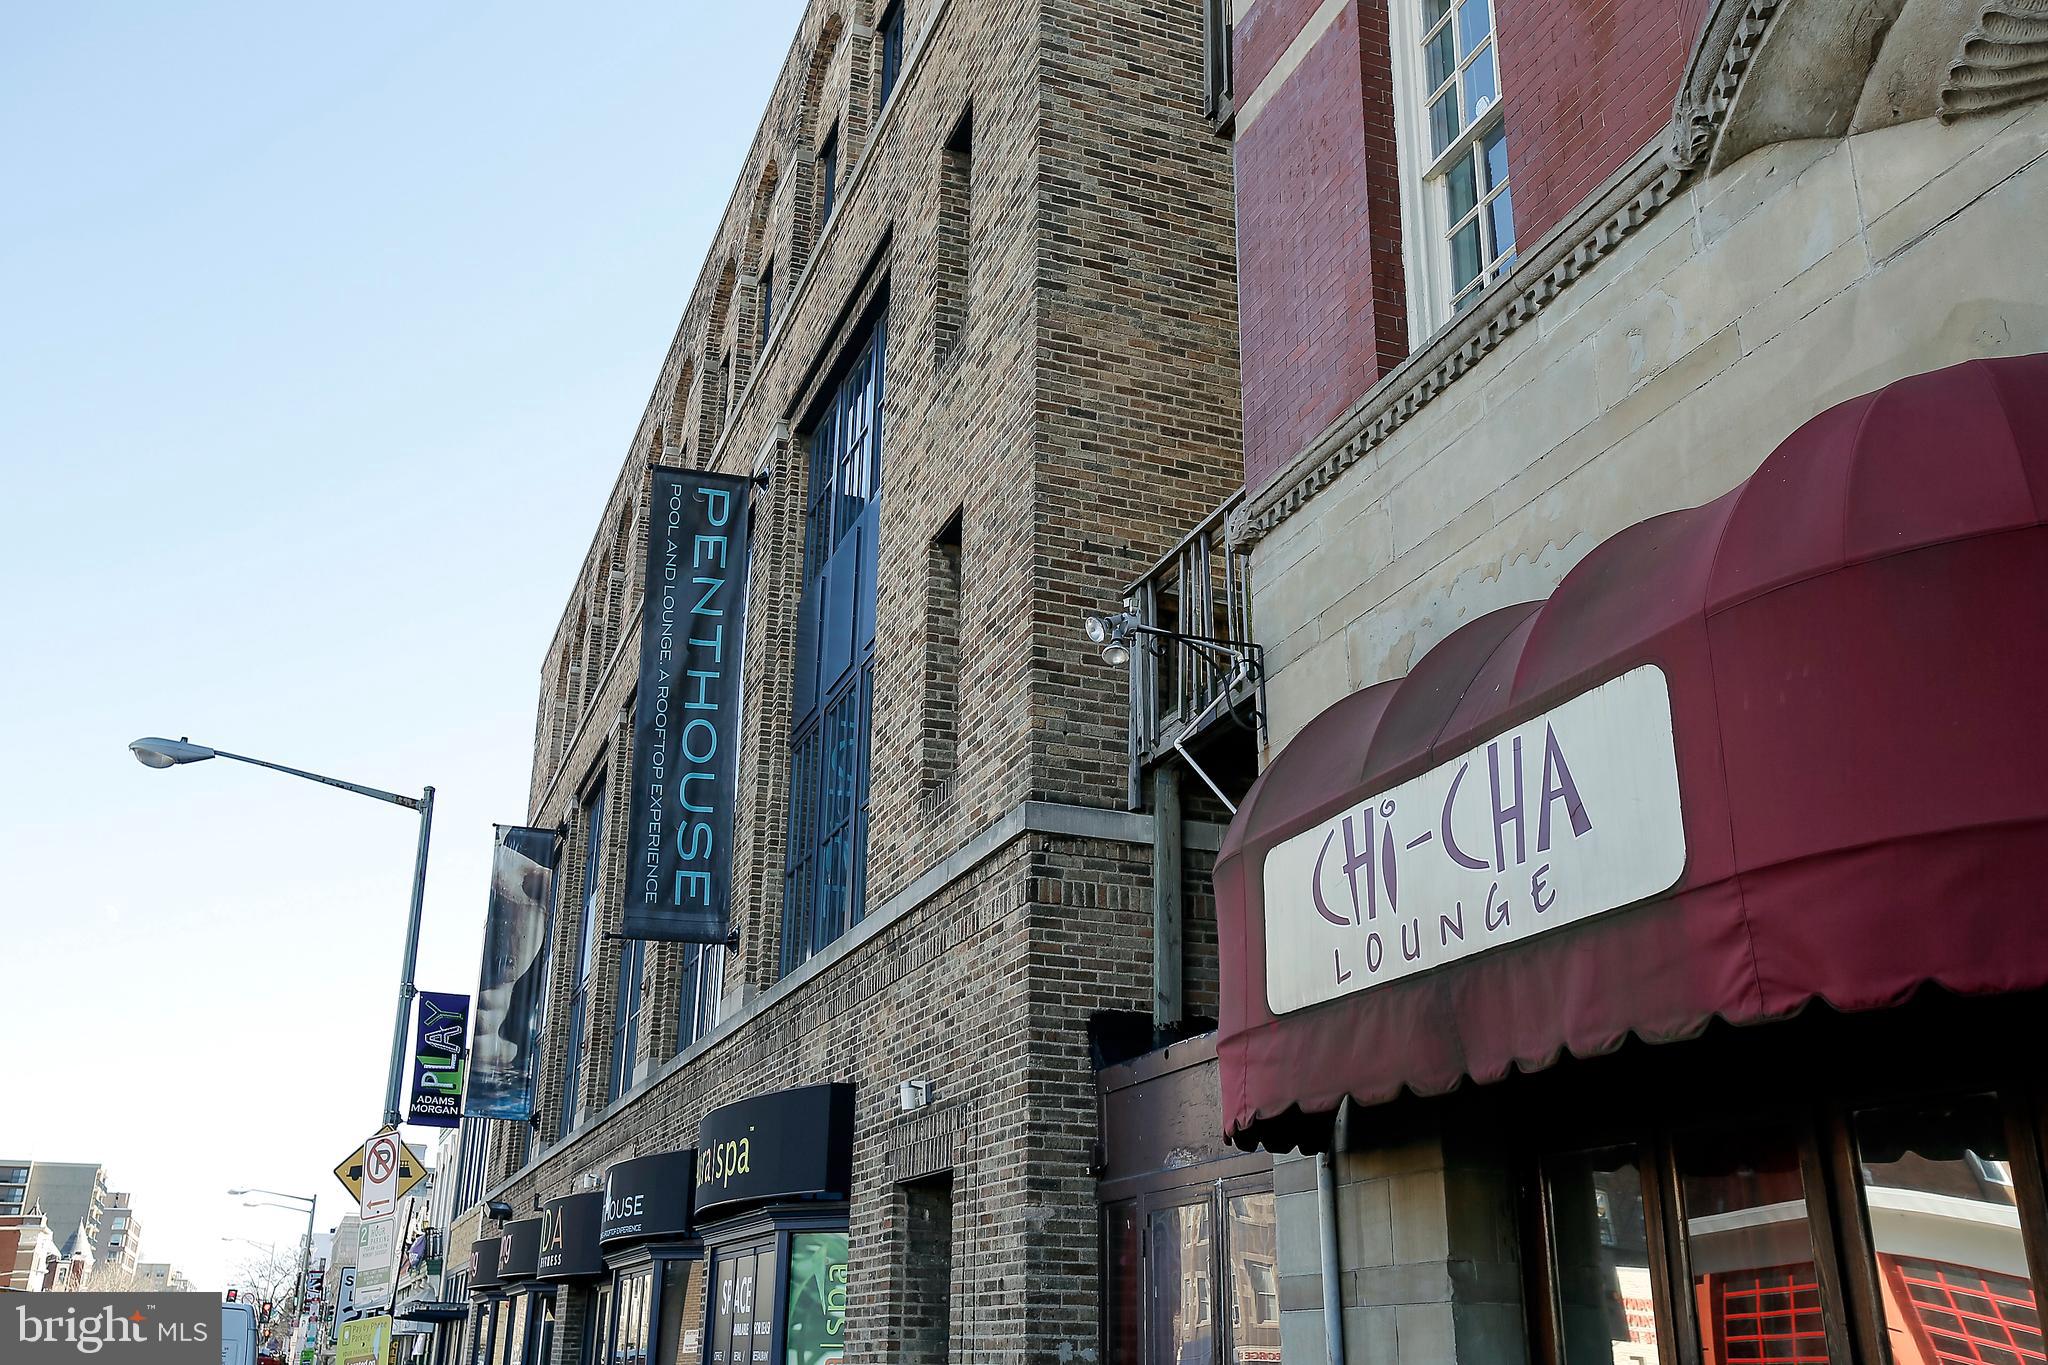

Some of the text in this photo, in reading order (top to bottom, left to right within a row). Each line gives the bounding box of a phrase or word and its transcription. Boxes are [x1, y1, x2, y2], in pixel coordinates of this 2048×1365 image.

[667, 483, 682, 536] POOL
[664, 539, 678, 581] AND
[658, 669, 670, 682] A
[674, 487, 731, 906] PENTHOUSE
[652, 686, 670, 779] ROOFTOP
[645, 784, 663, 904] EXPERIENCE
[1334, 863, 1557, 985] LOUNGE
[420, 1000, 463, 1088] PLAY
[410, 1103, 459, 1115] MORGAN
[416, 1095, 455, 1105] ADAMS
[360, 1227, 368, 1243] 2
[721, 1276, 752, 1315] SPACE
